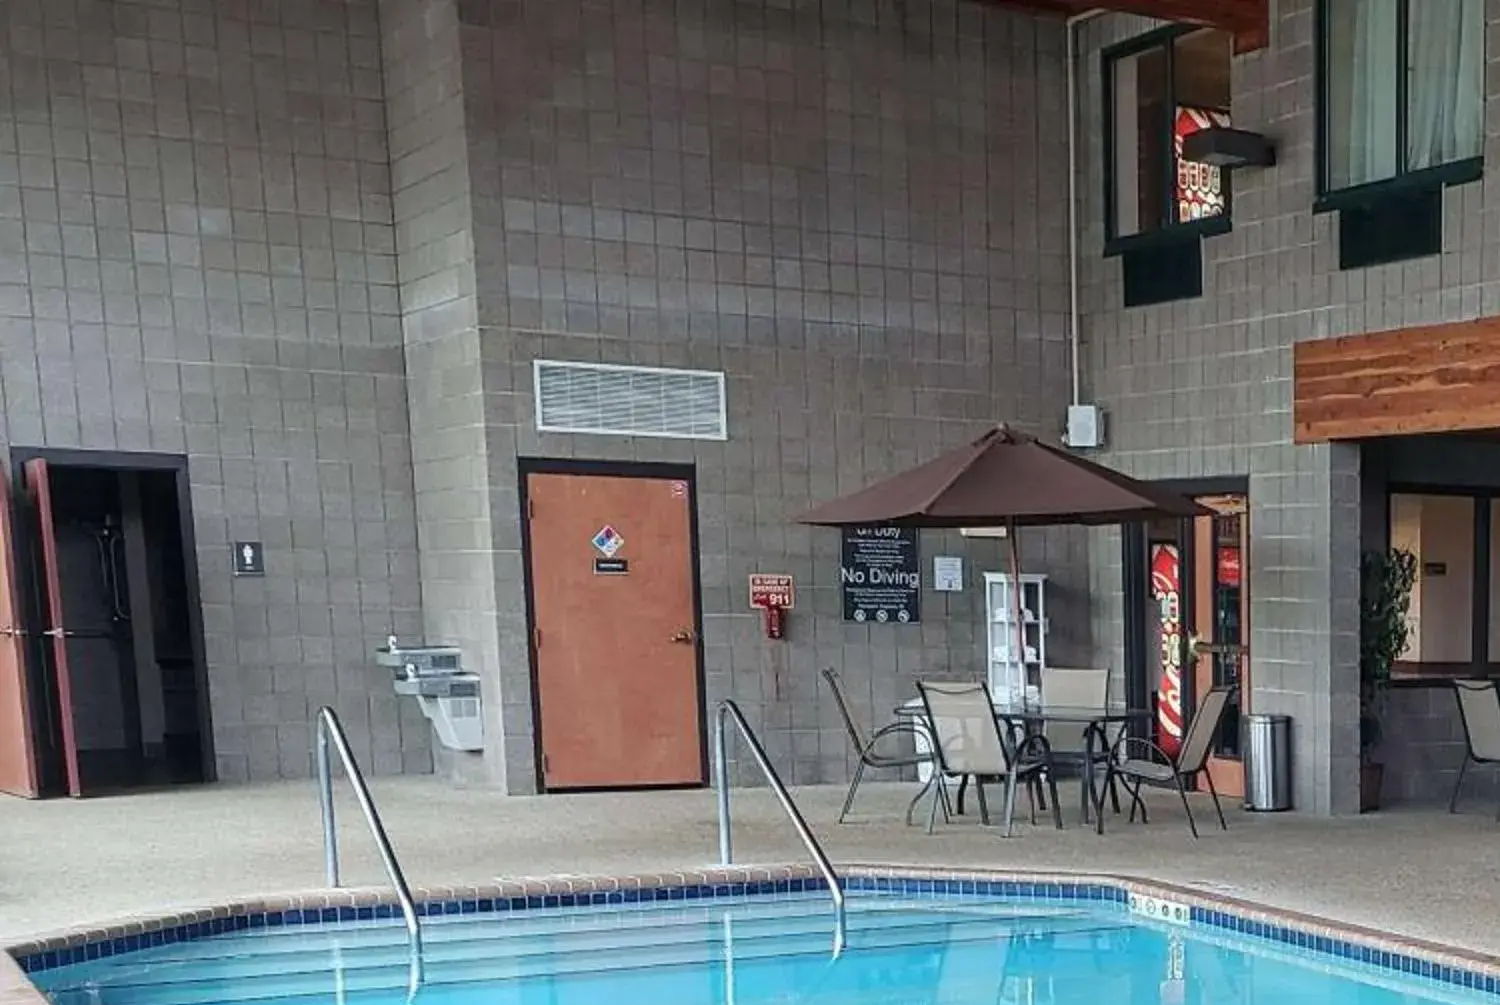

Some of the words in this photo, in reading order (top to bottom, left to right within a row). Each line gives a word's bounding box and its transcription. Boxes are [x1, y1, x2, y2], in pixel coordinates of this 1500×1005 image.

[841, 567, 865, 583] No
[869, 567, 919, 588] Diving
[770, 593, 789, 604] 911
